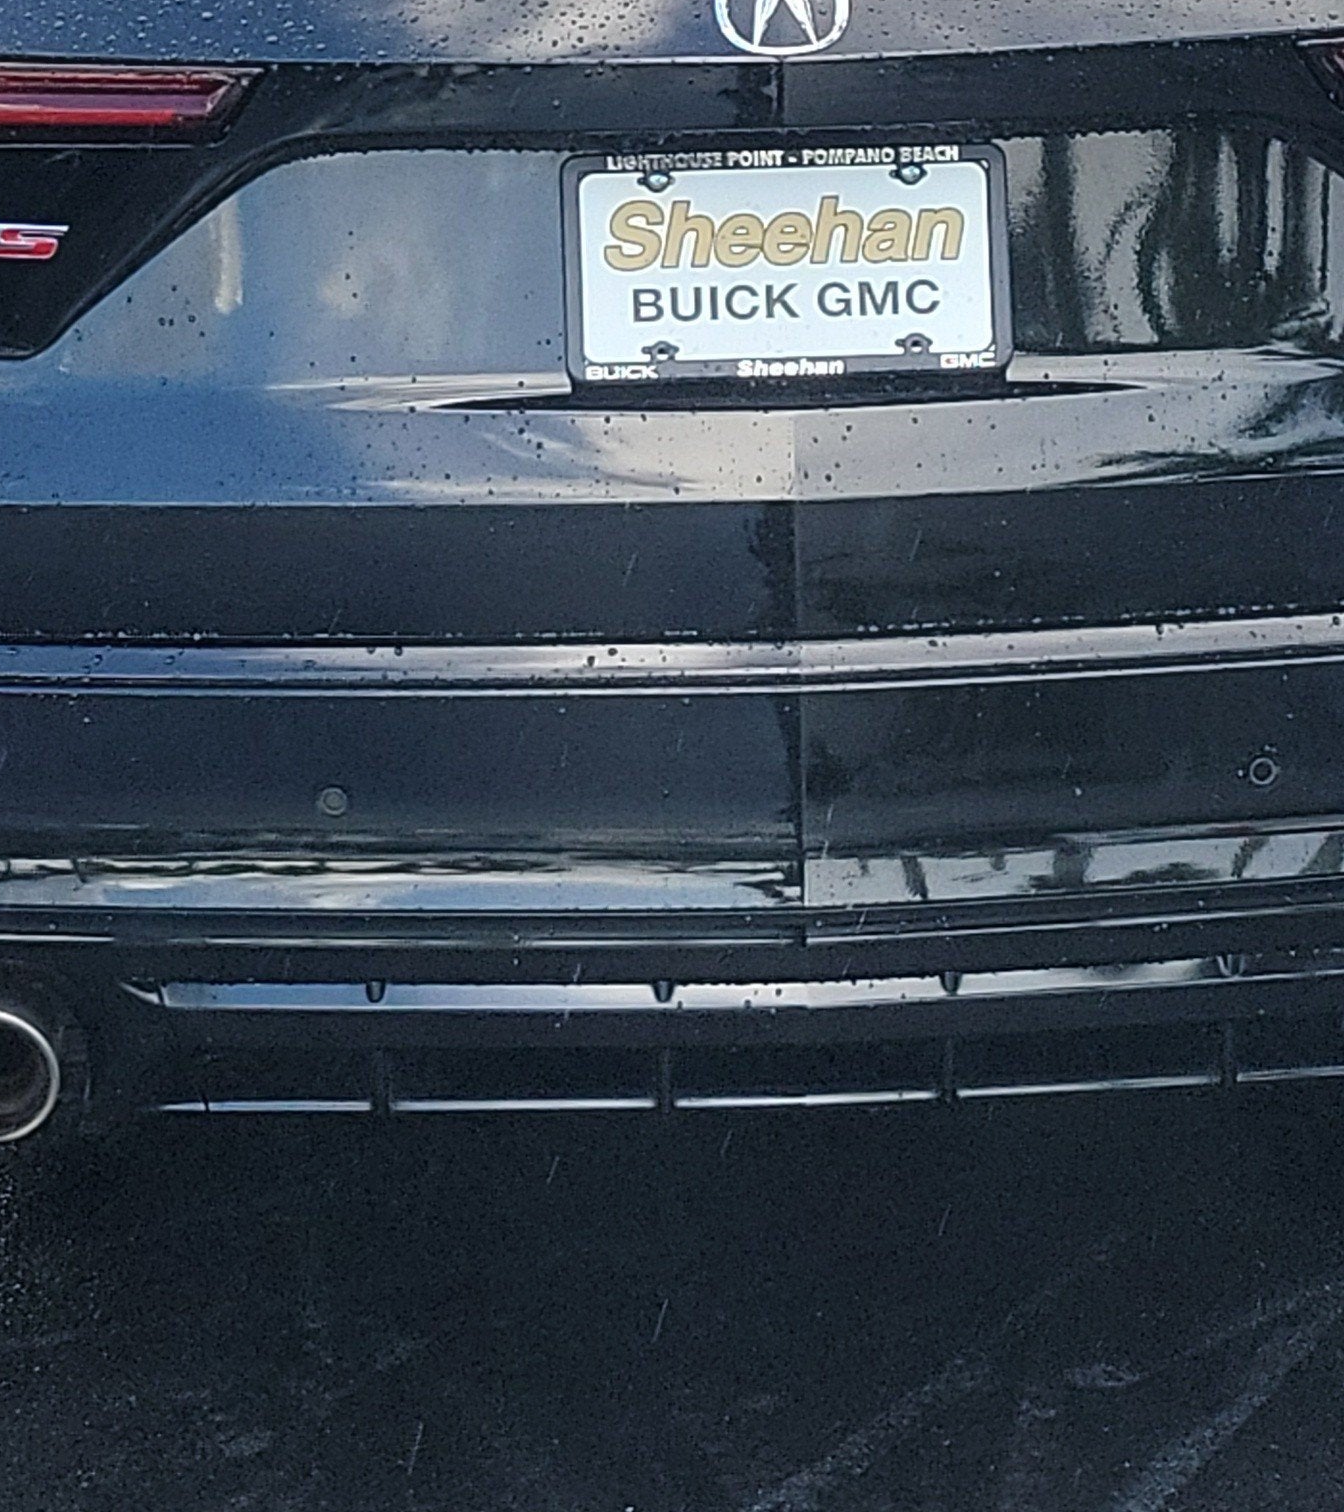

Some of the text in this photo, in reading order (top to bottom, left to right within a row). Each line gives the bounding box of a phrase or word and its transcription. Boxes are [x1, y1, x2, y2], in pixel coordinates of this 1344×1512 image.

[606, 152, 722, 171] LIGHTHOUSE
[727, 149, 785, 168] POINT
[801, 147, 896, 165] POMPANO
[899, 145, 959, 163] BEACH
[602, 195, 965, 271] Sheehan
[632, 278, 942, 323] BUICK GMC
[585, 350, 997, 381] BUICK Sheehan GMC
